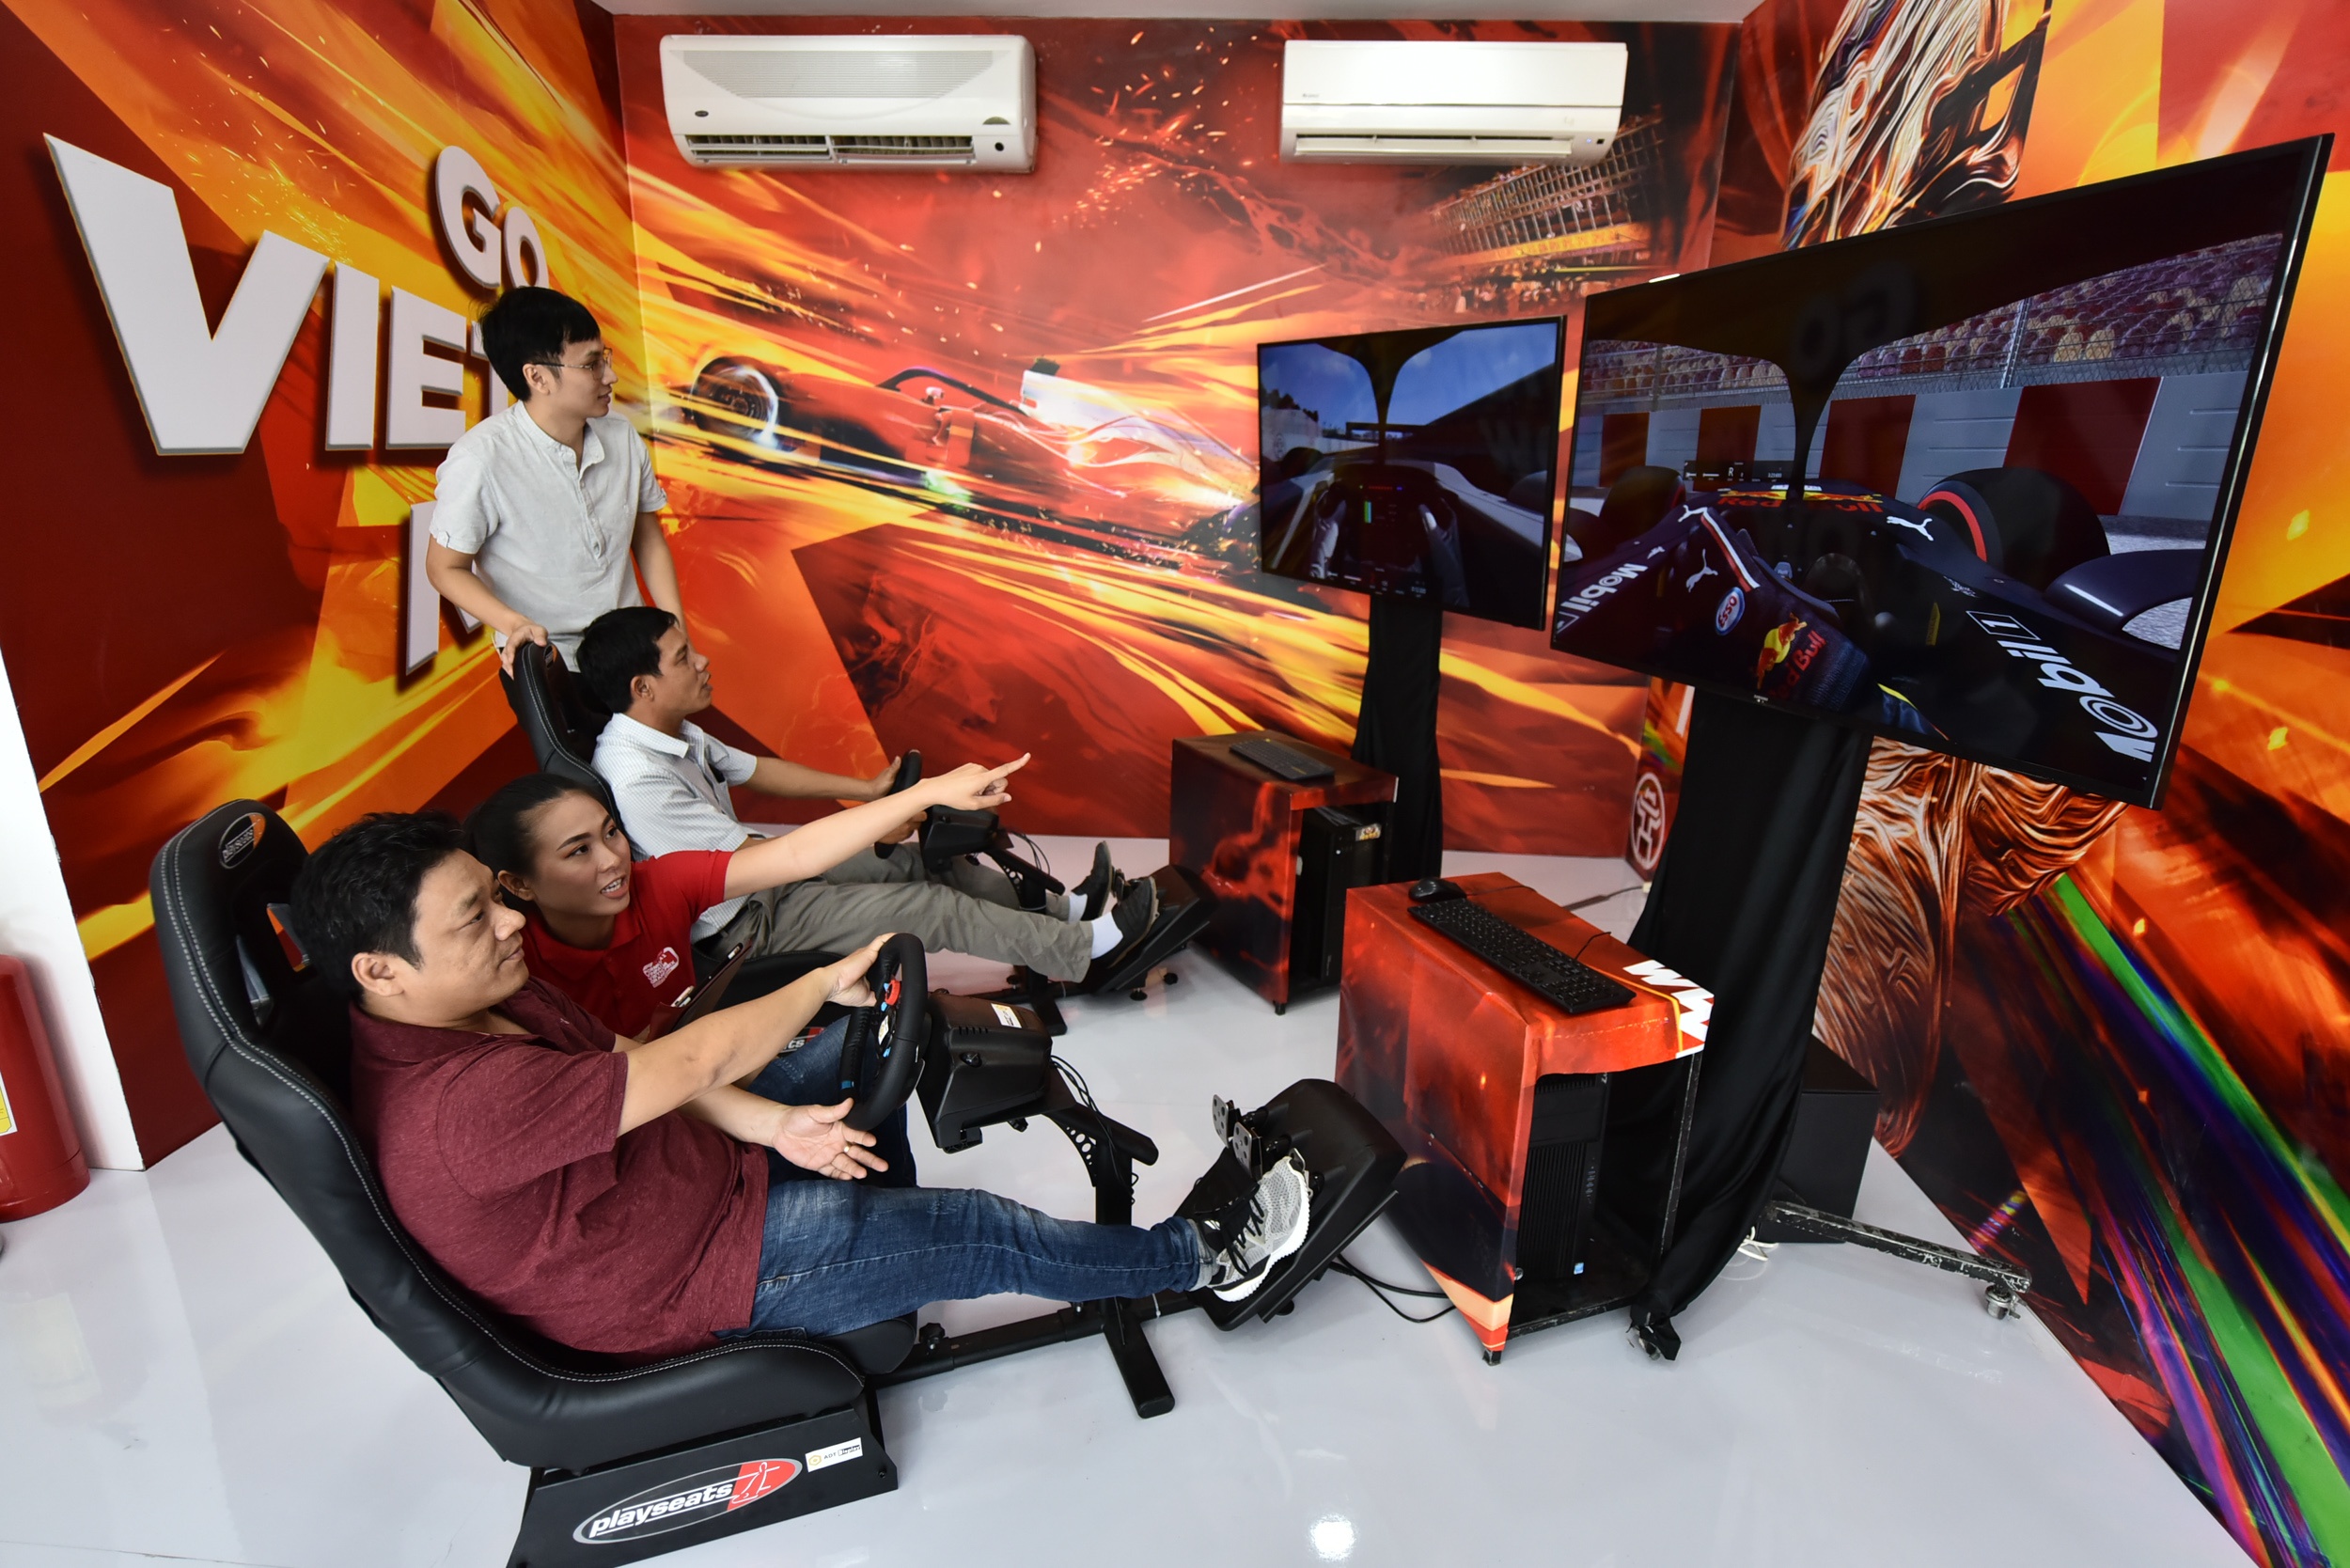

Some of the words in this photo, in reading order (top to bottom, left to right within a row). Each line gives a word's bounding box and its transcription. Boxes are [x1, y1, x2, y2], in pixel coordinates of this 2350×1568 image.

[435, 145, 550, 289] GO
[1717, 497, 1783, 509] Red
[1822, 502, 1883, 513] ull
[1560, 563, 1648, 612] Mobil
[1981, 619, 2021, 629] 1
[1793, 630, 1826, 671] Bull
[588, 1482, 733, 1539] playseats
